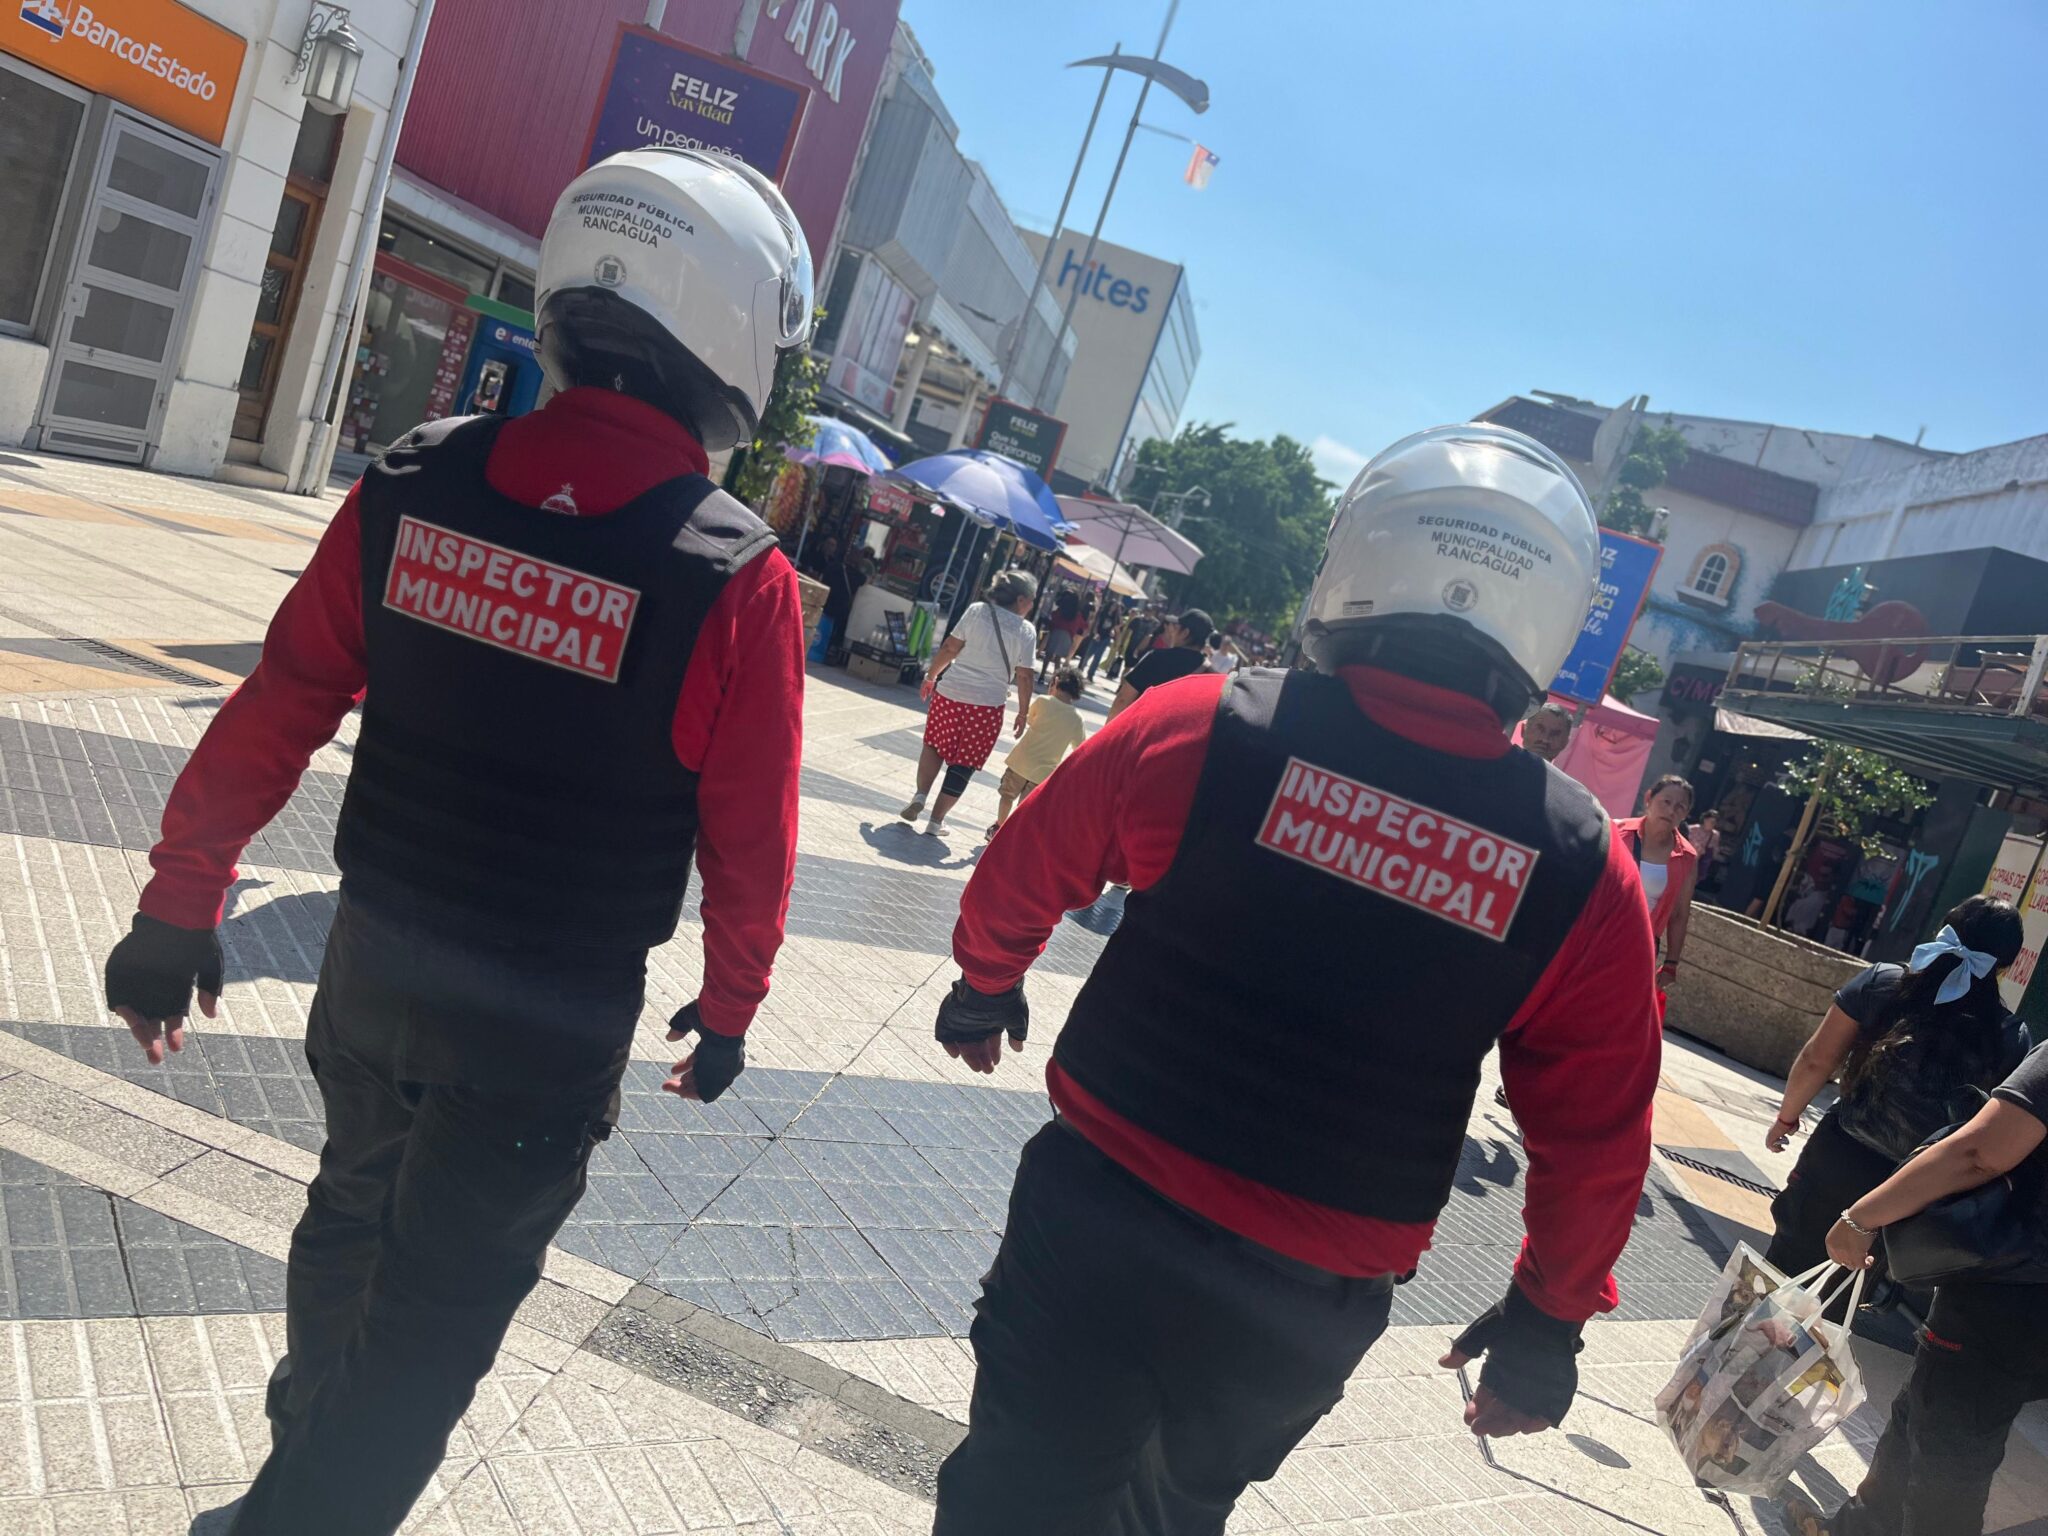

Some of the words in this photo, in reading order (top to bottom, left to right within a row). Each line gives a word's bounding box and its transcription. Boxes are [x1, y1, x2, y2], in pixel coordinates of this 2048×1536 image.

[71, 5, 216, 101] BancoEstado
[767, 0, 856, 103] ARK
[671, 72, 738, 111] FELIZ
[636, 116, 661, 140] Un
[572, 193, 634, 206] SEGURIDAD
[637, 201, 695, 236] PÚBLICA
[578, 205, 672, 239] MUNICIPALIDAD
[583, 216, 658, 248] RANCAGUA
[1057, 249, 1150, 313] hites
[1010, 416, 1039, 433] FELIZ
[1417, 515, 1498, 538] SEGURIDAD
[1502, 531, 1552, 564] PÚBLICA
[1431, 531, 1533, 571] MUNICIPALIDAD
[1437, 543, 1520, 580] RANCAGUA
[400, 523, 629, 629] INSPECTOR
[395, 571, 606, 672] MUNICIPAL
[1282, 766, 1527, 888] INSPECTOR
[1271, 811, 1495, 930] MUNICIPAL
